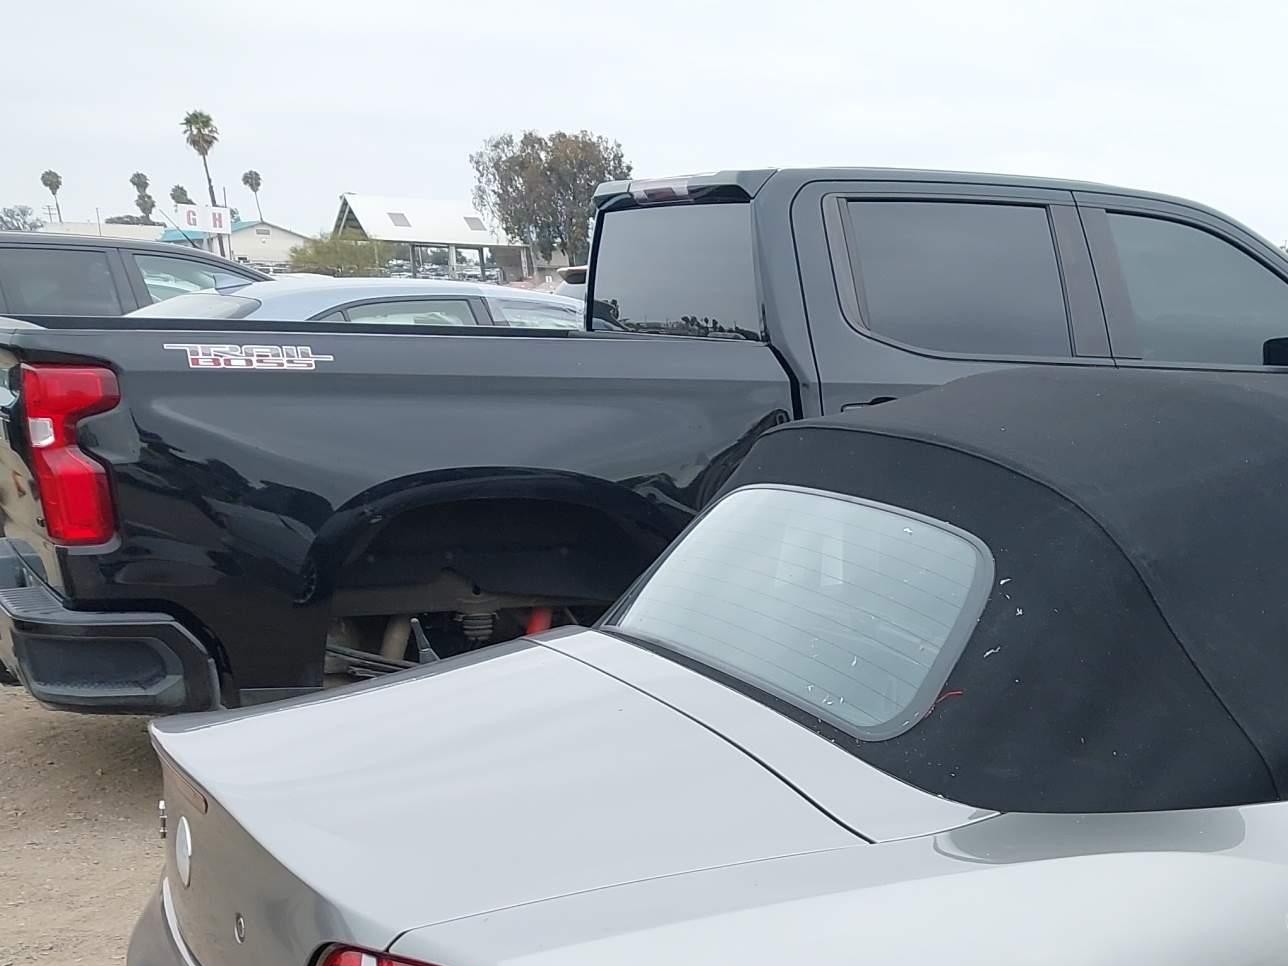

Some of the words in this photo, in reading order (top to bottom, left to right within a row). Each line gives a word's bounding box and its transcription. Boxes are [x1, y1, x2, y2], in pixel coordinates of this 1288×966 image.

[186, 209, 197, 226] G
[212, 212, 223, 228] H
[163, 344, 334, 360] TRAIL
[189, 357, 316, 370] BOSS
